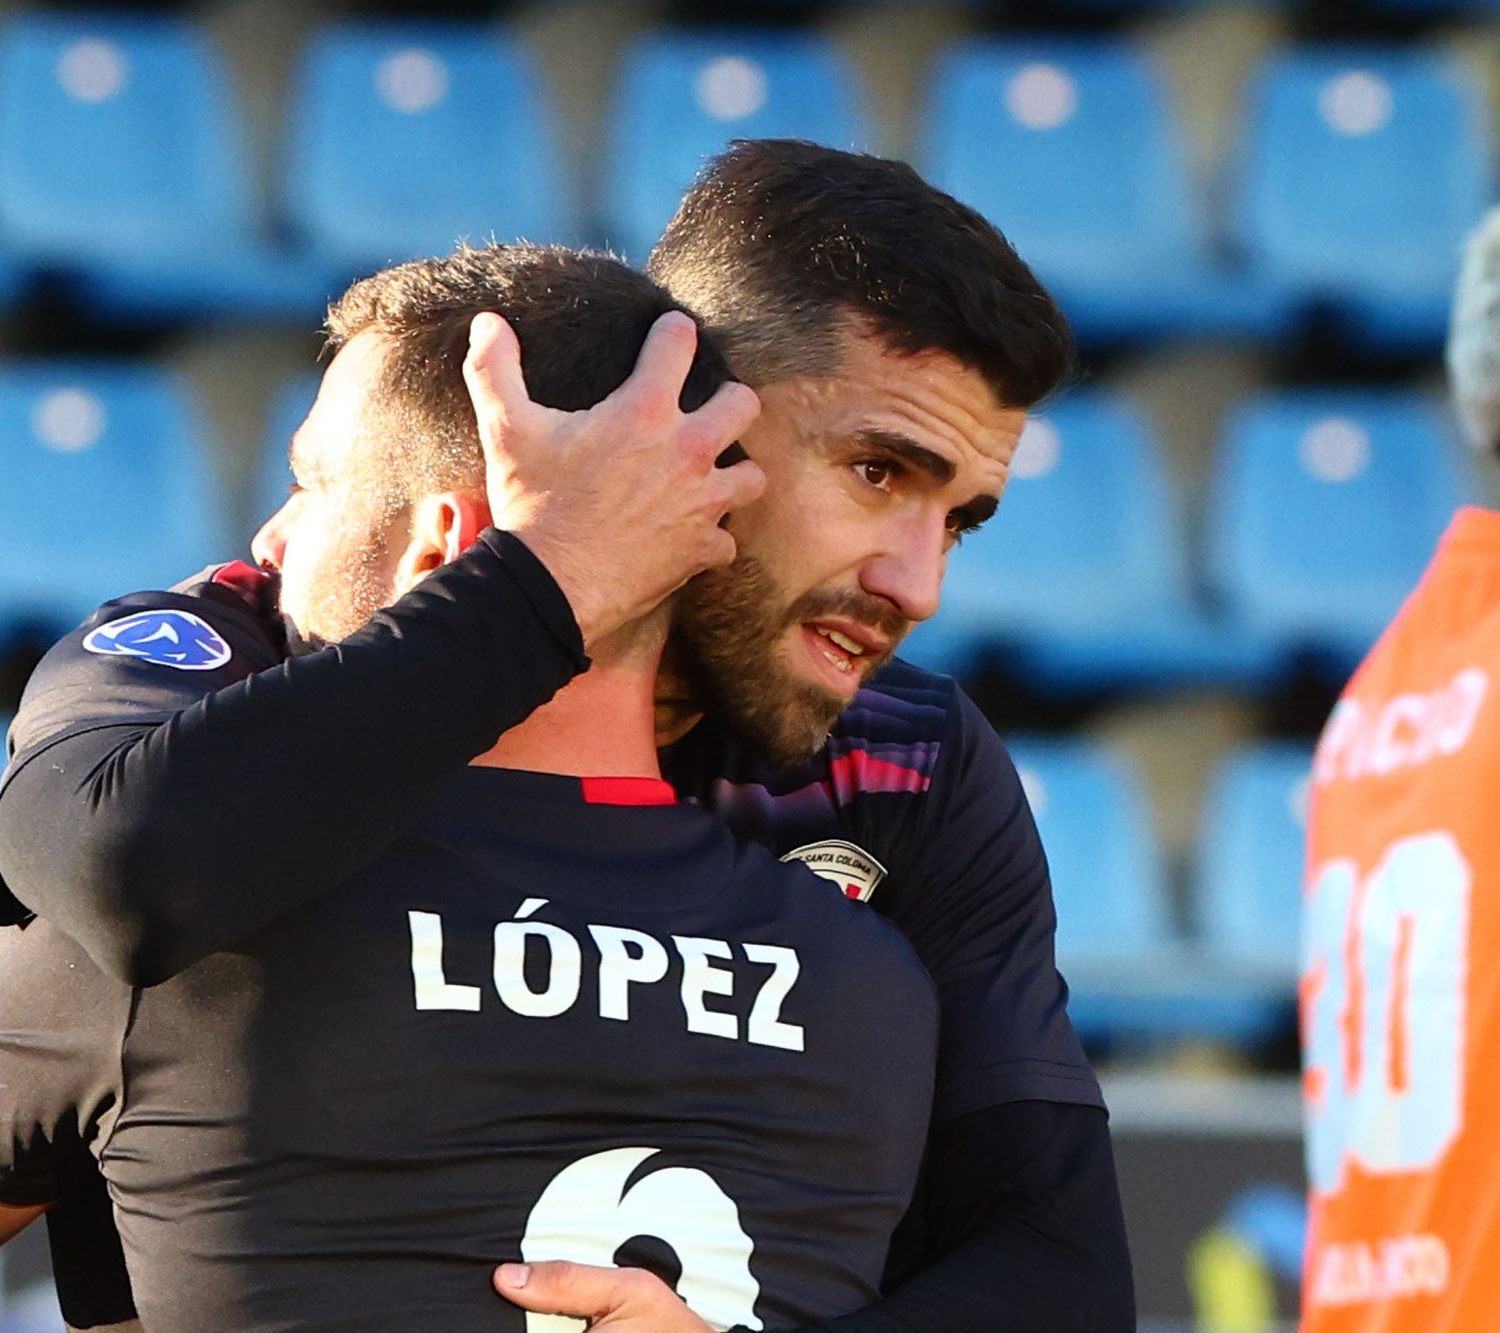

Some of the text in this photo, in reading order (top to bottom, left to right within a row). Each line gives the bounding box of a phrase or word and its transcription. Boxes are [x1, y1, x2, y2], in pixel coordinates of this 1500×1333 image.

[805, 853, 872, 875] SANTA COLOMA
[408, 898, 805, 1052] LÓPEZ
